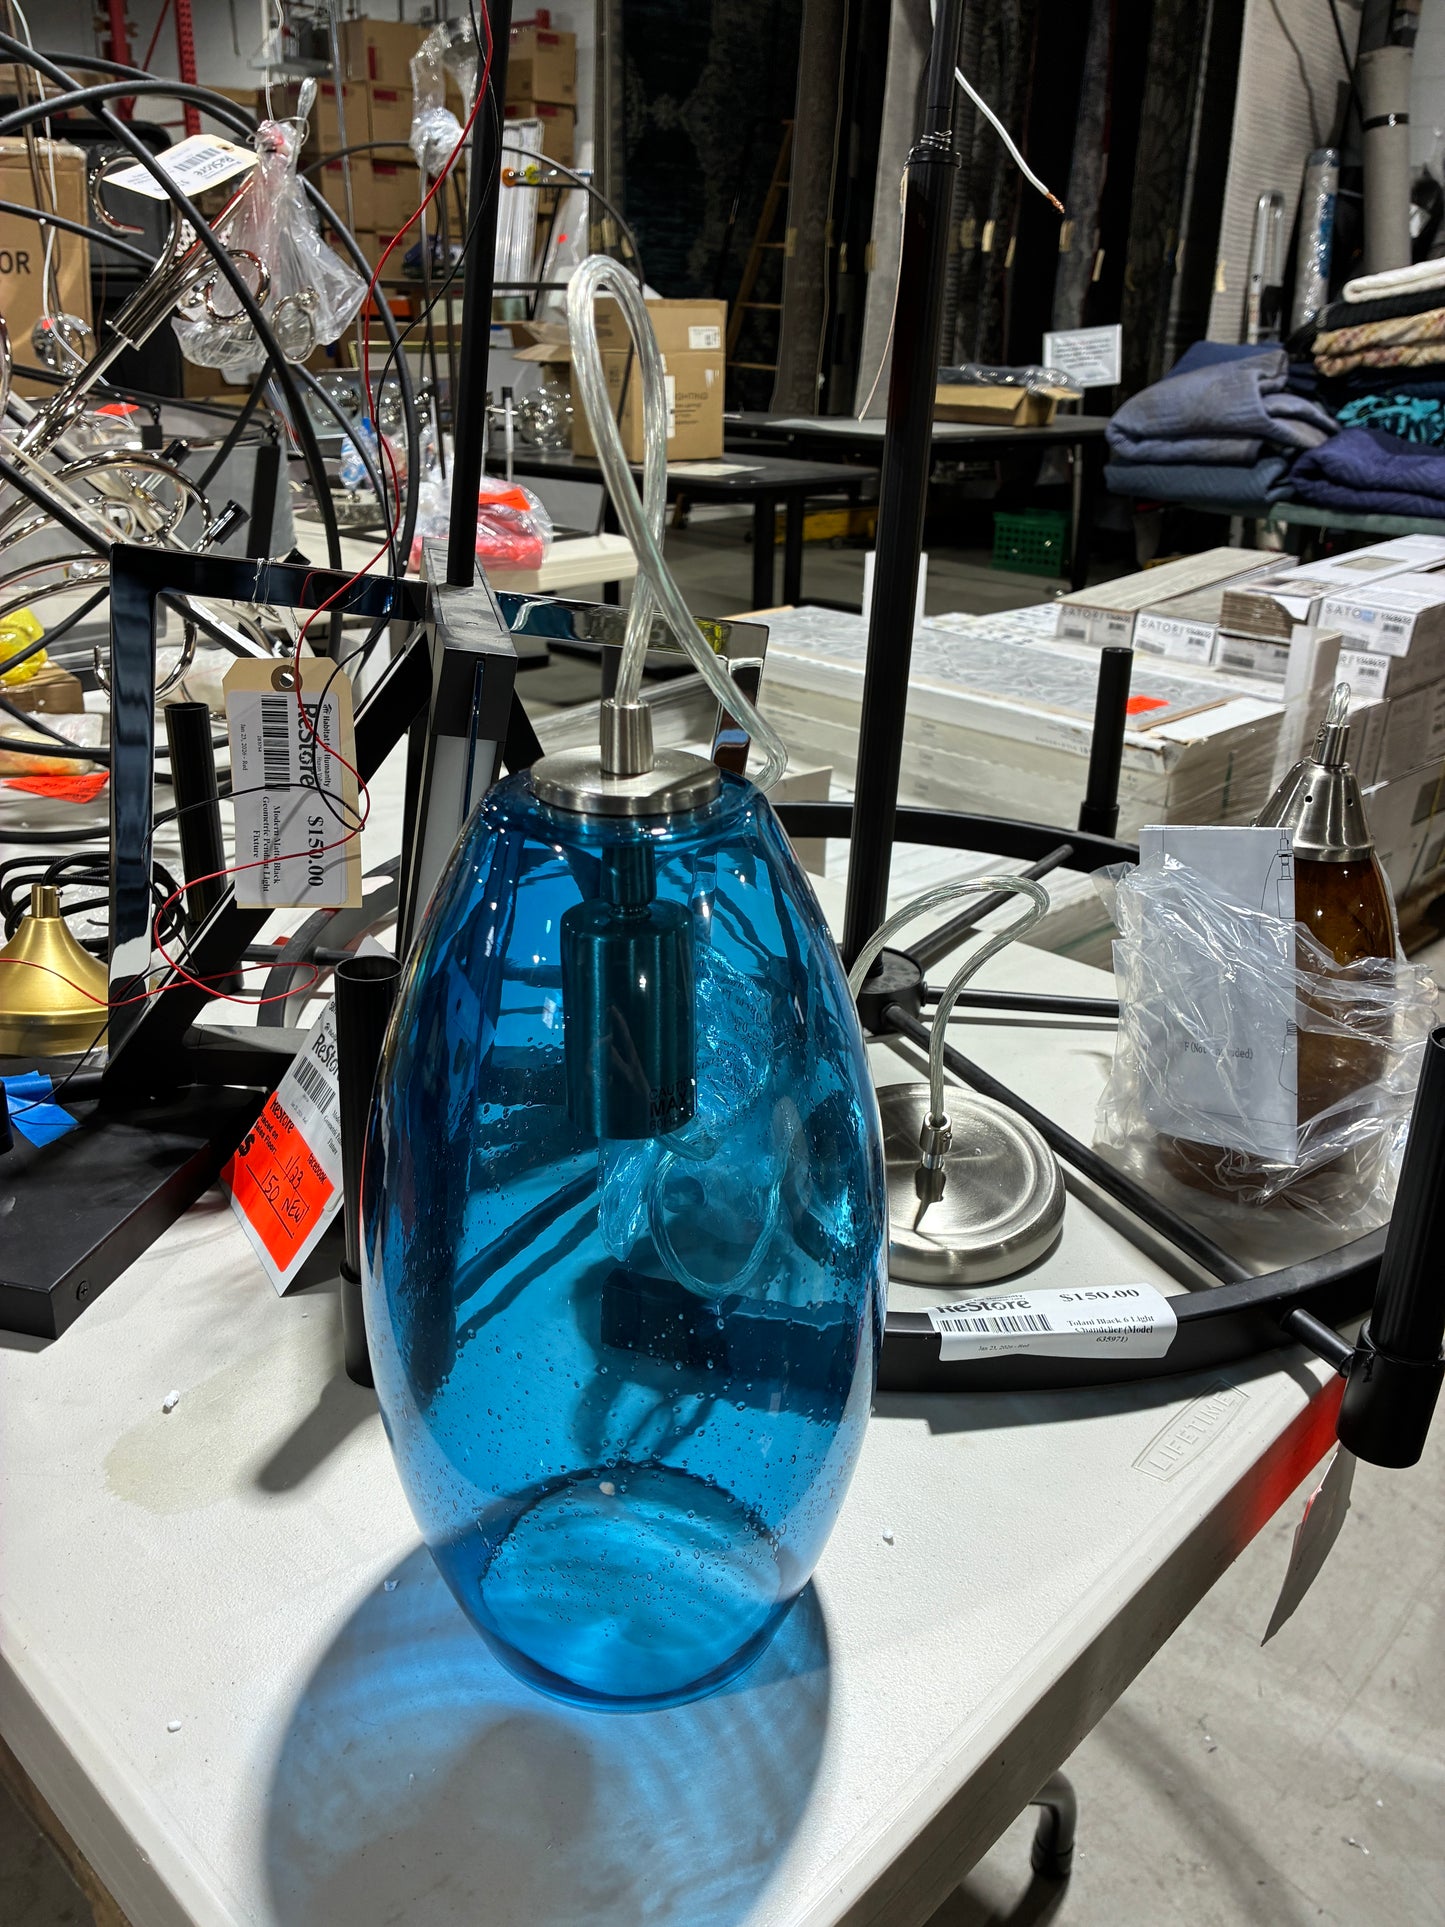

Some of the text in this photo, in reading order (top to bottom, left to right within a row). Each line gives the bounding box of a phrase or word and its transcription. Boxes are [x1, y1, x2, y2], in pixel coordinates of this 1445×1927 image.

[1141, 618, 1184, 634] SATORI
[323, 715, 331, 740] Habitat
[298, 704, 319, 786] ReStore
[323, 754, 331, 788] Humanity
[308, 815, 324, 886] $150.00
[261, 871, 270, 892] Light
[312, 1033, 339, 1080] ReStor
[651, 1090, 687, 1117] MAX
[238, 1133, 255, 1158] $
[307, 1153, 327, 1184] facebook
[261, 1169, 306, 1223] 150 NEW
[936, 1300, 1031, 1313] ReStore
[1059, 1289, 1140, 1302] $150.00
[1067, 1319, 1095, 1327] Tolani
[1096, 1317, 1121, 1325] Black
[1130, 1315, 1155, 1323] Light
[1124, 1325, 1153, 1335] (Model
[1147, 1391, 1236, 1471] LIFETIME
